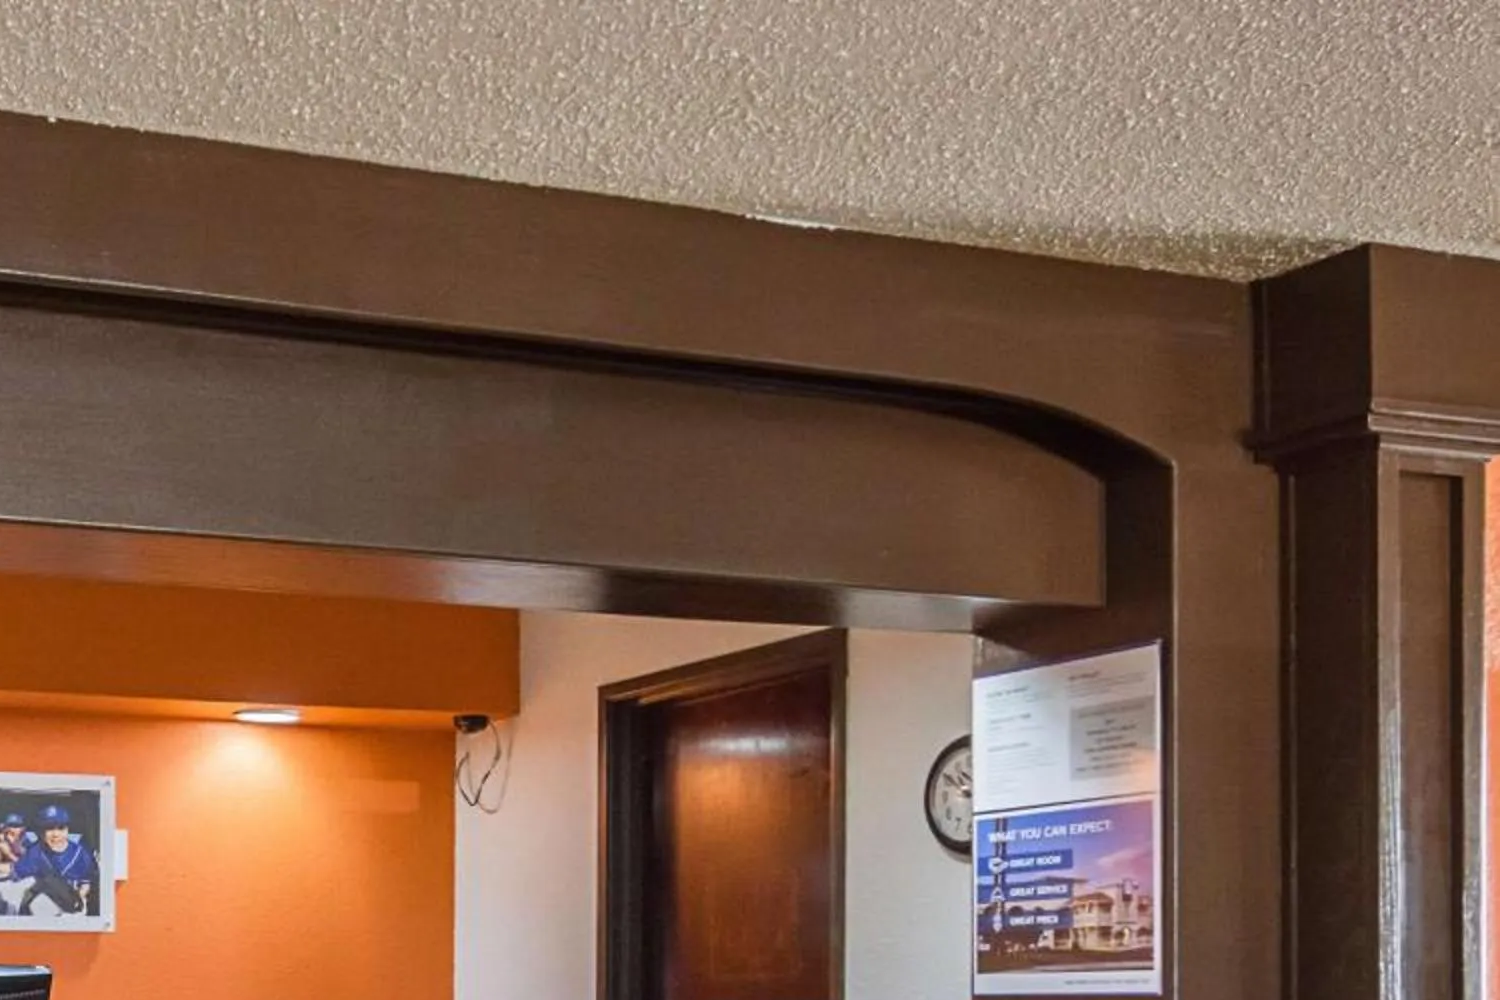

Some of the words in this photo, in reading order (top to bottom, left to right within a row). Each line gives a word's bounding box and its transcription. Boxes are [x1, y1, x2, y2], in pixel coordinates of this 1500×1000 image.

[988, 829, 1017, 843] WHAT
[1020, 827, 1042, 840] YOU
[1044, 824, 1067, 838] CAN
